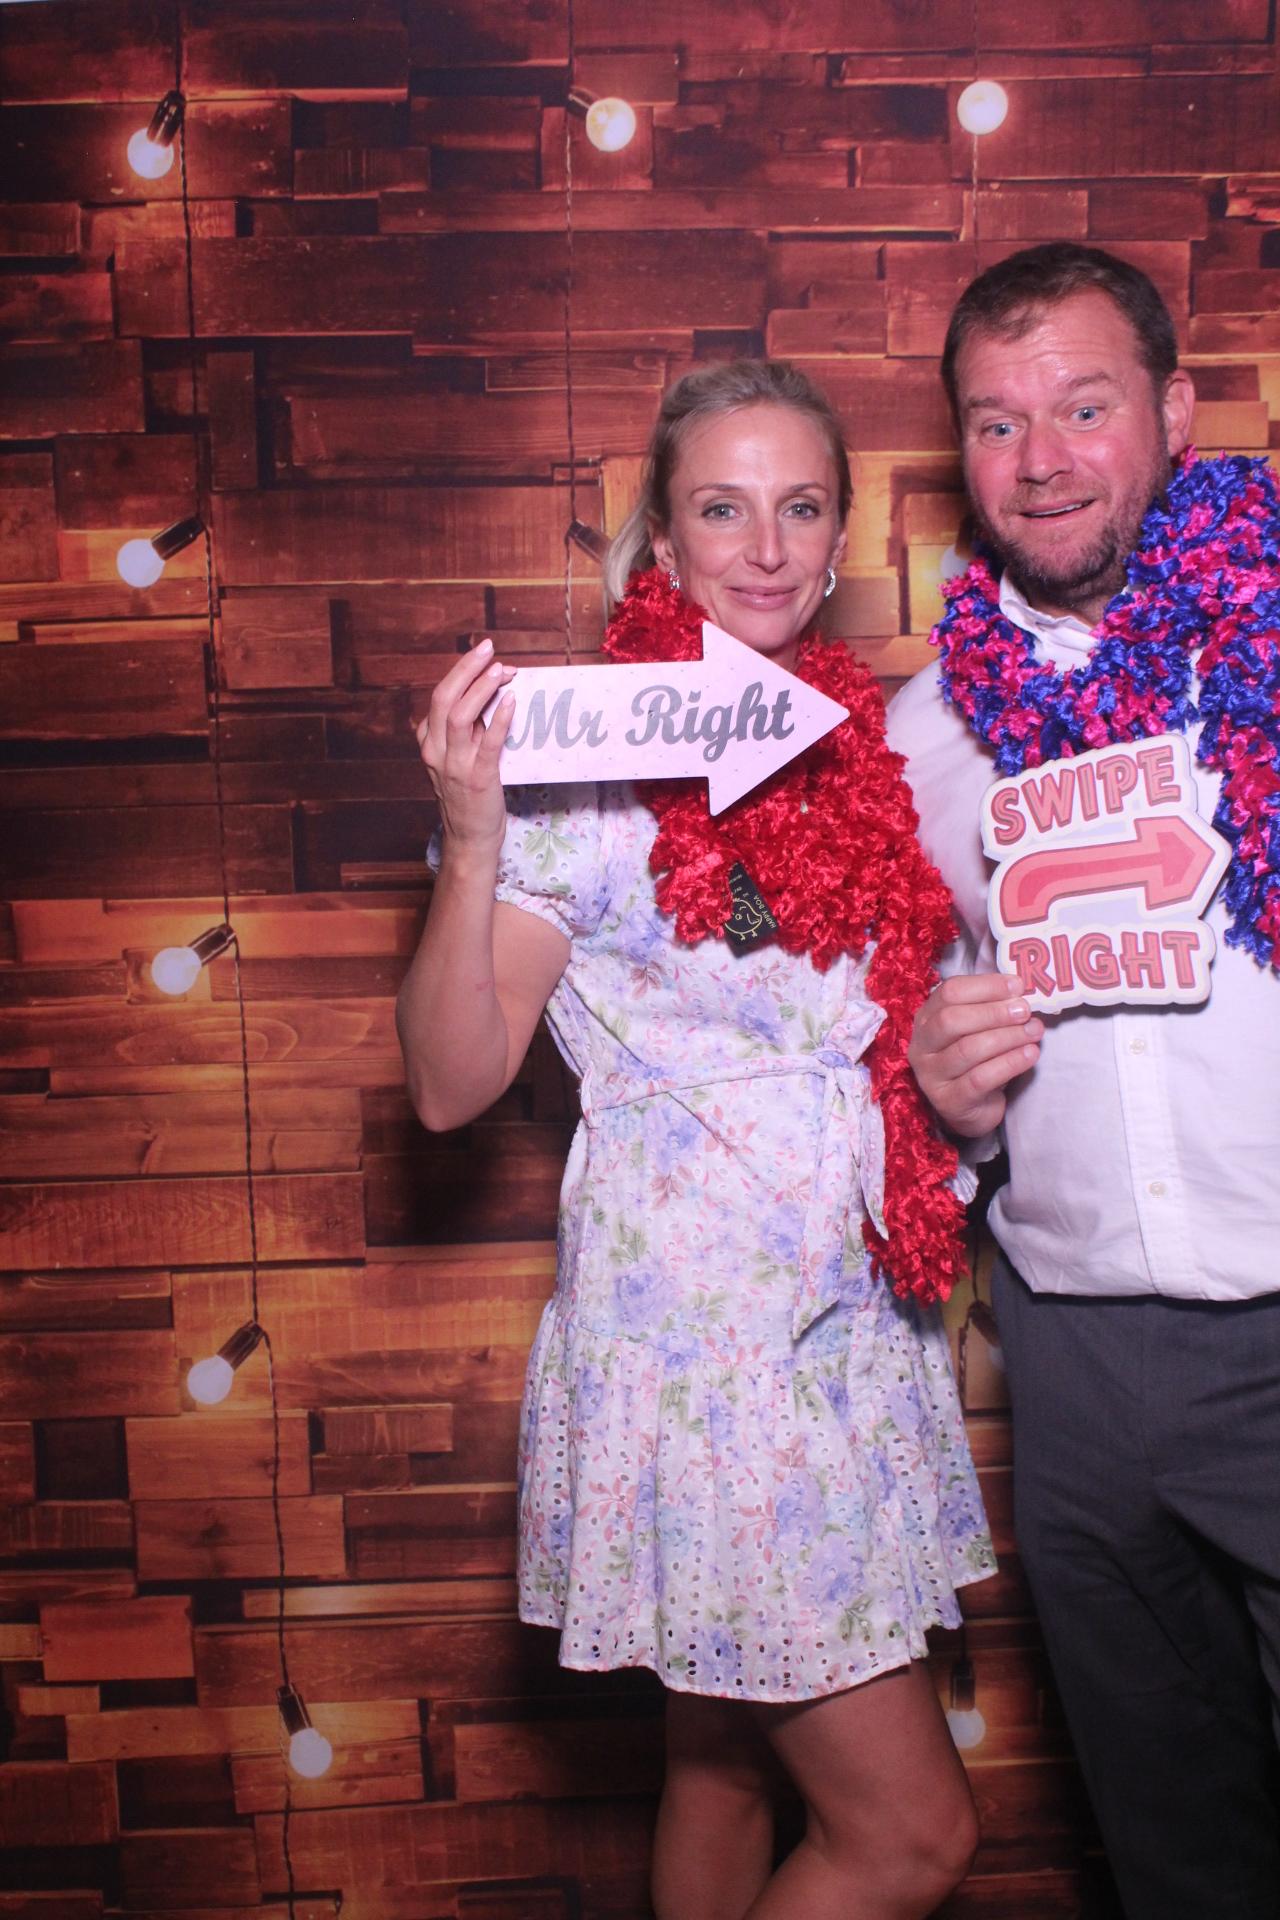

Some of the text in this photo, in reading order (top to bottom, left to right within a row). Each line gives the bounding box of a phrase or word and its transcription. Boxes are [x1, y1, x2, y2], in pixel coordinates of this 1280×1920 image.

[505, 681, 795, 763] Mr Right
[991, 745, 1181, 845] SWIPE
[754, 894, 777, 929] HAPPY BOA
[1009, 931, 1200, 996] RIGHT
